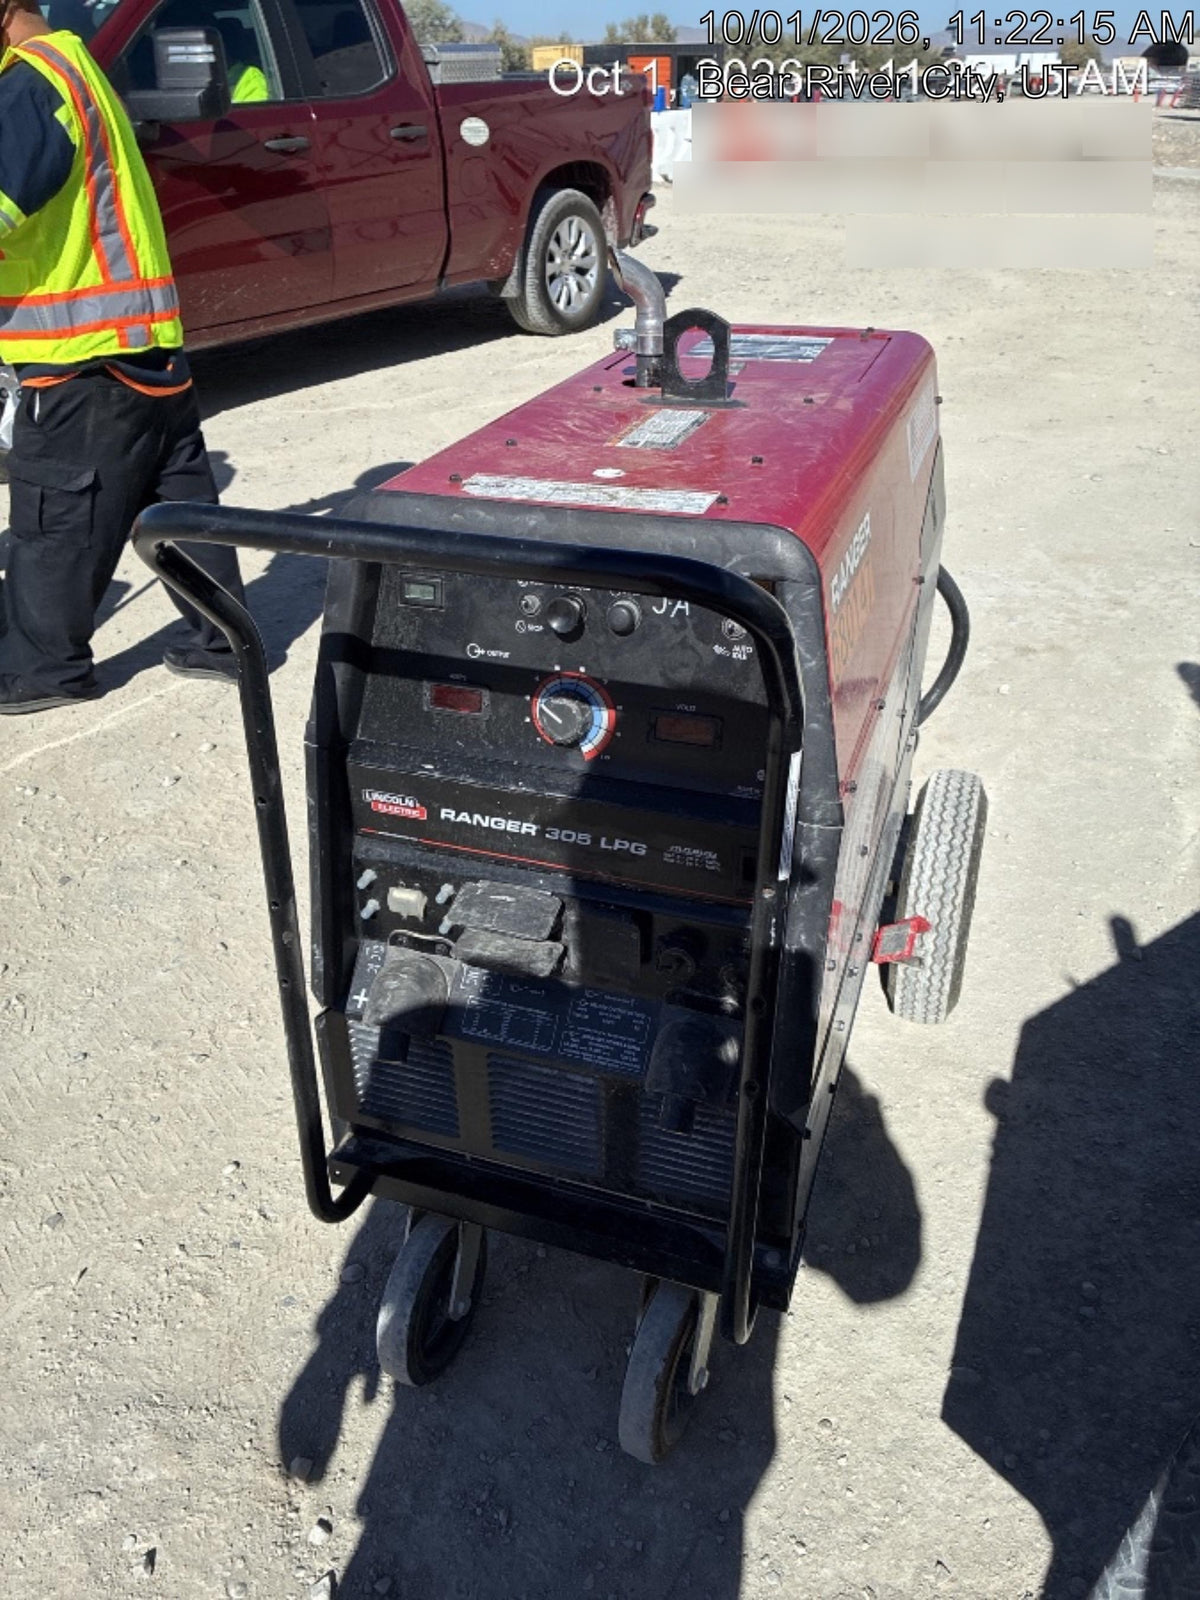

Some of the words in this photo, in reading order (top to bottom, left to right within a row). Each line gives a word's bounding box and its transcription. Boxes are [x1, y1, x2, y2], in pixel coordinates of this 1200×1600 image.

[362, 788, 421, 808] LINCOLN
[377, 802, 421, 818] ELECTRIC
[440, 808, 537, 836] RANGER
[545, 827, 592, 846] 305
[600, 836, 648, 856] LPG
